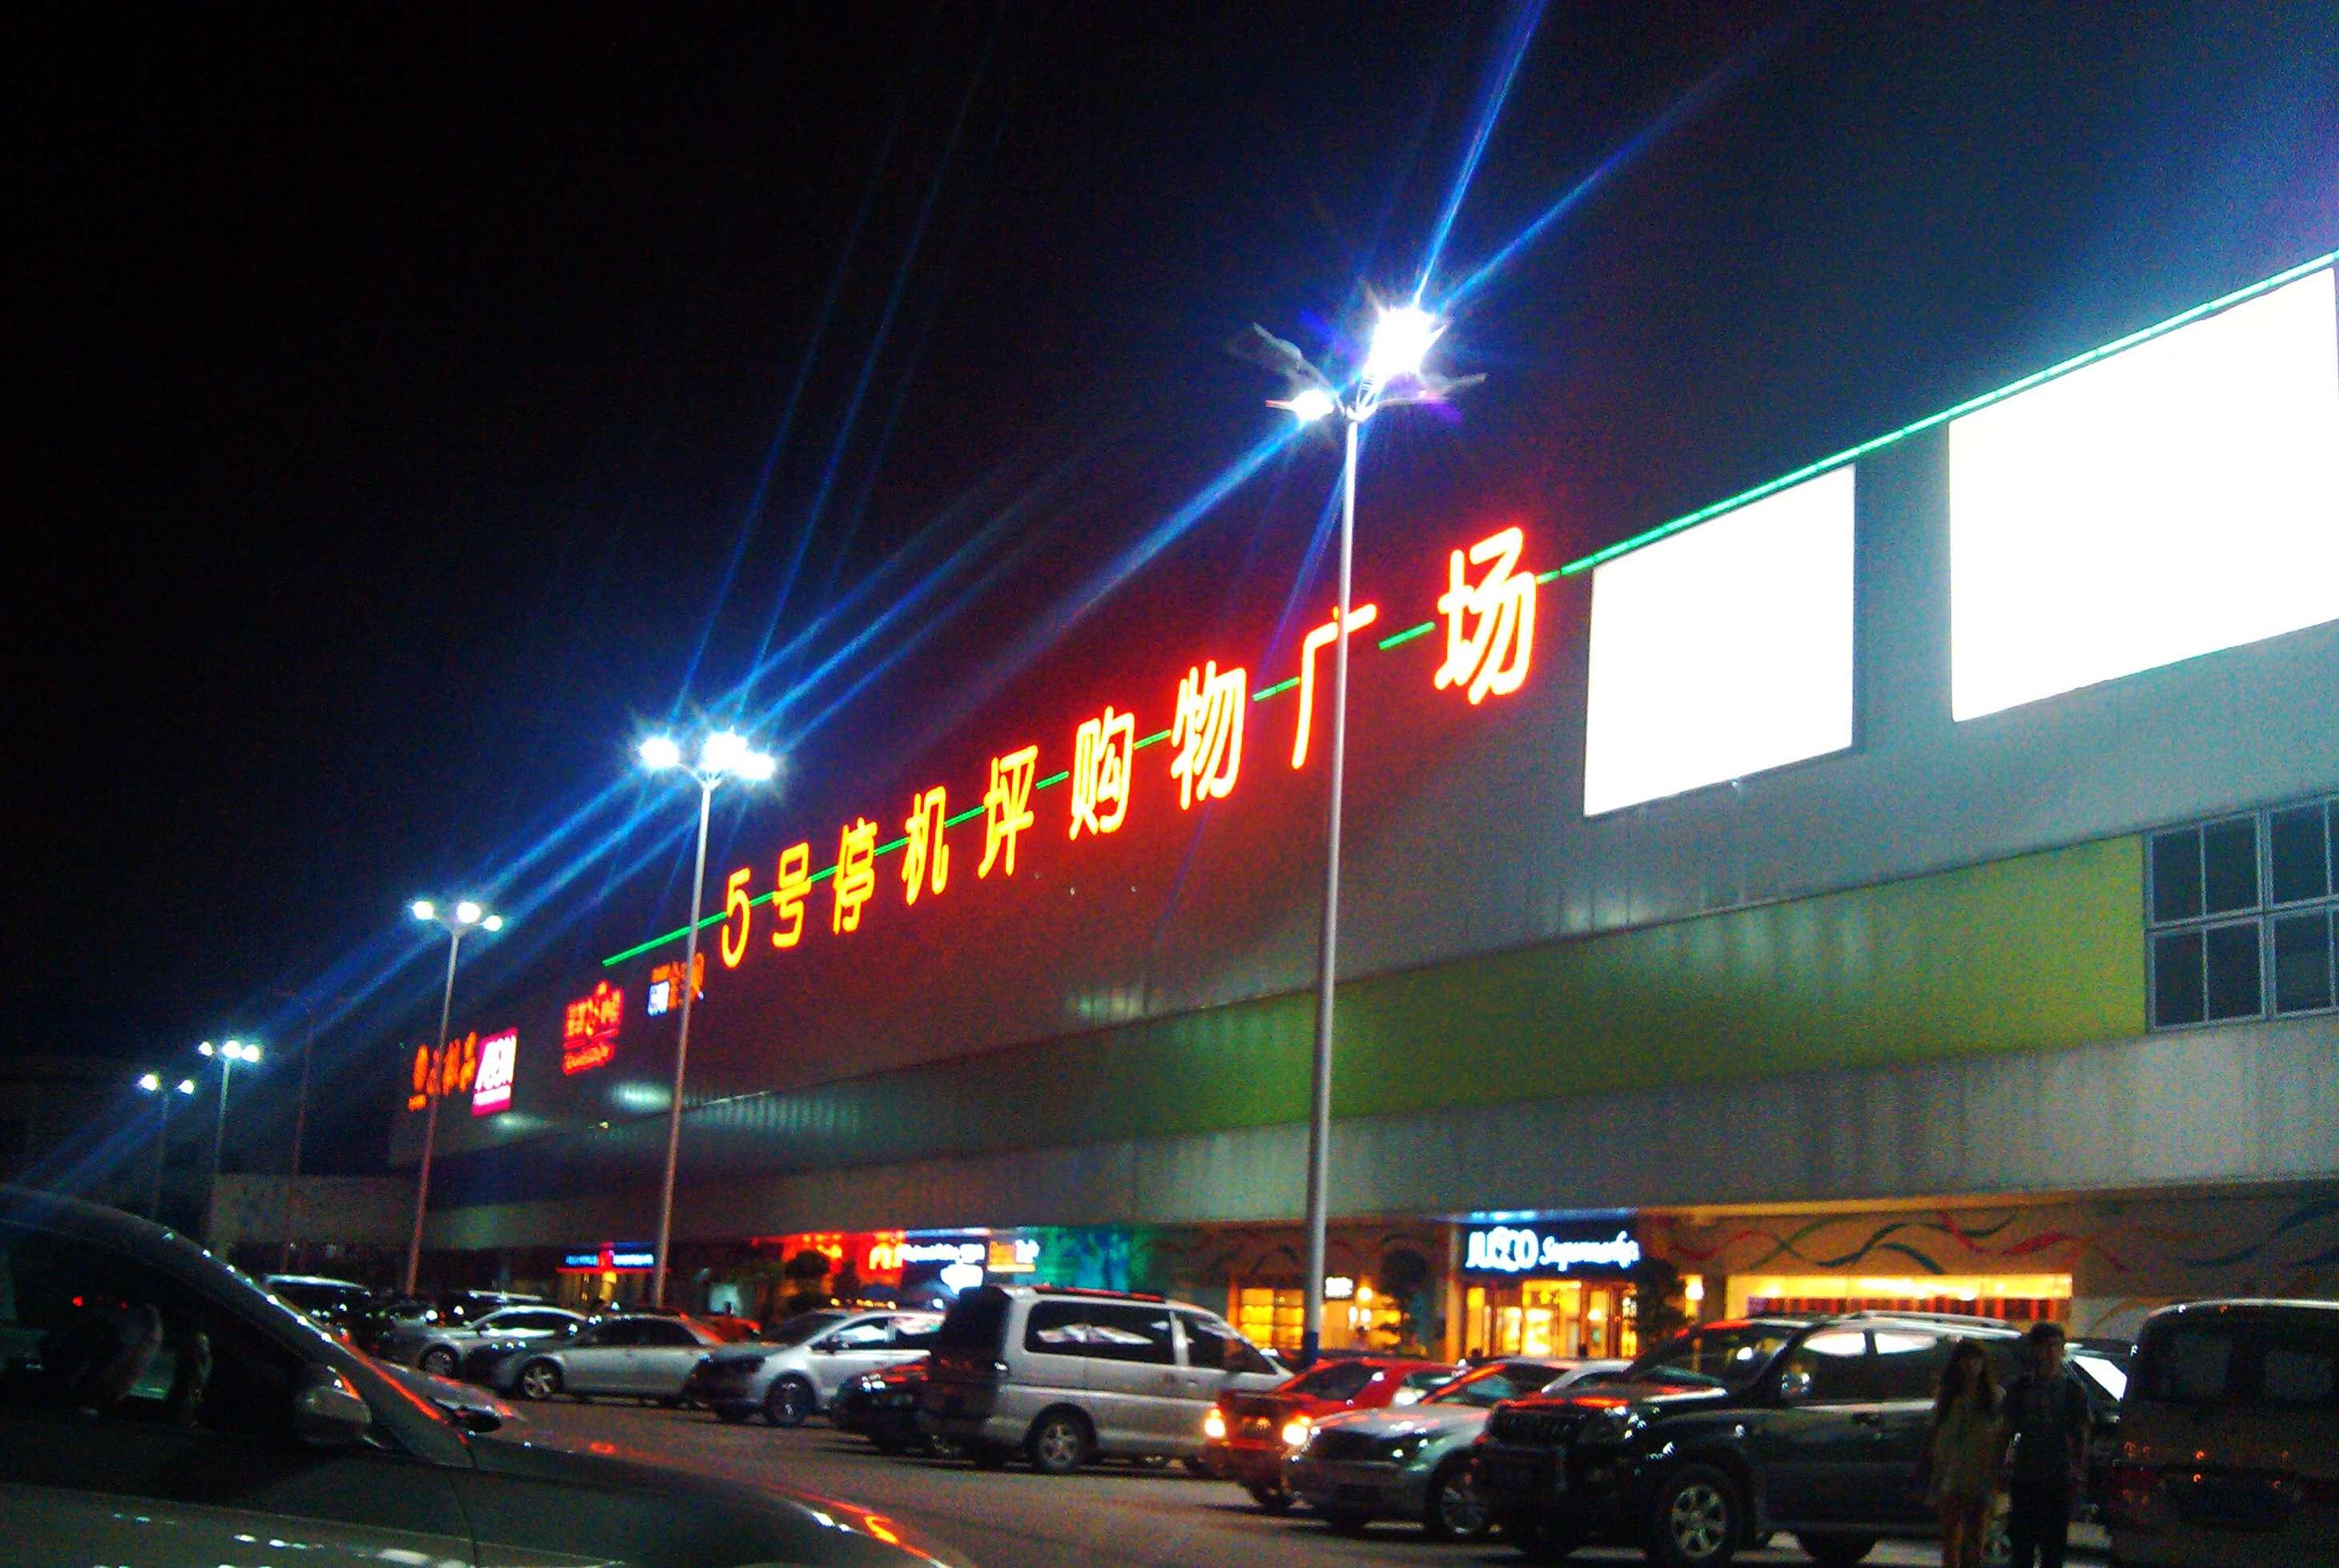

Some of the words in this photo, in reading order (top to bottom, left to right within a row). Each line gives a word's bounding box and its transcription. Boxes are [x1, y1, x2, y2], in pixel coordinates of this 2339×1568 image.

[721, 525, 1537, 970] 5号停机坪购物广场
